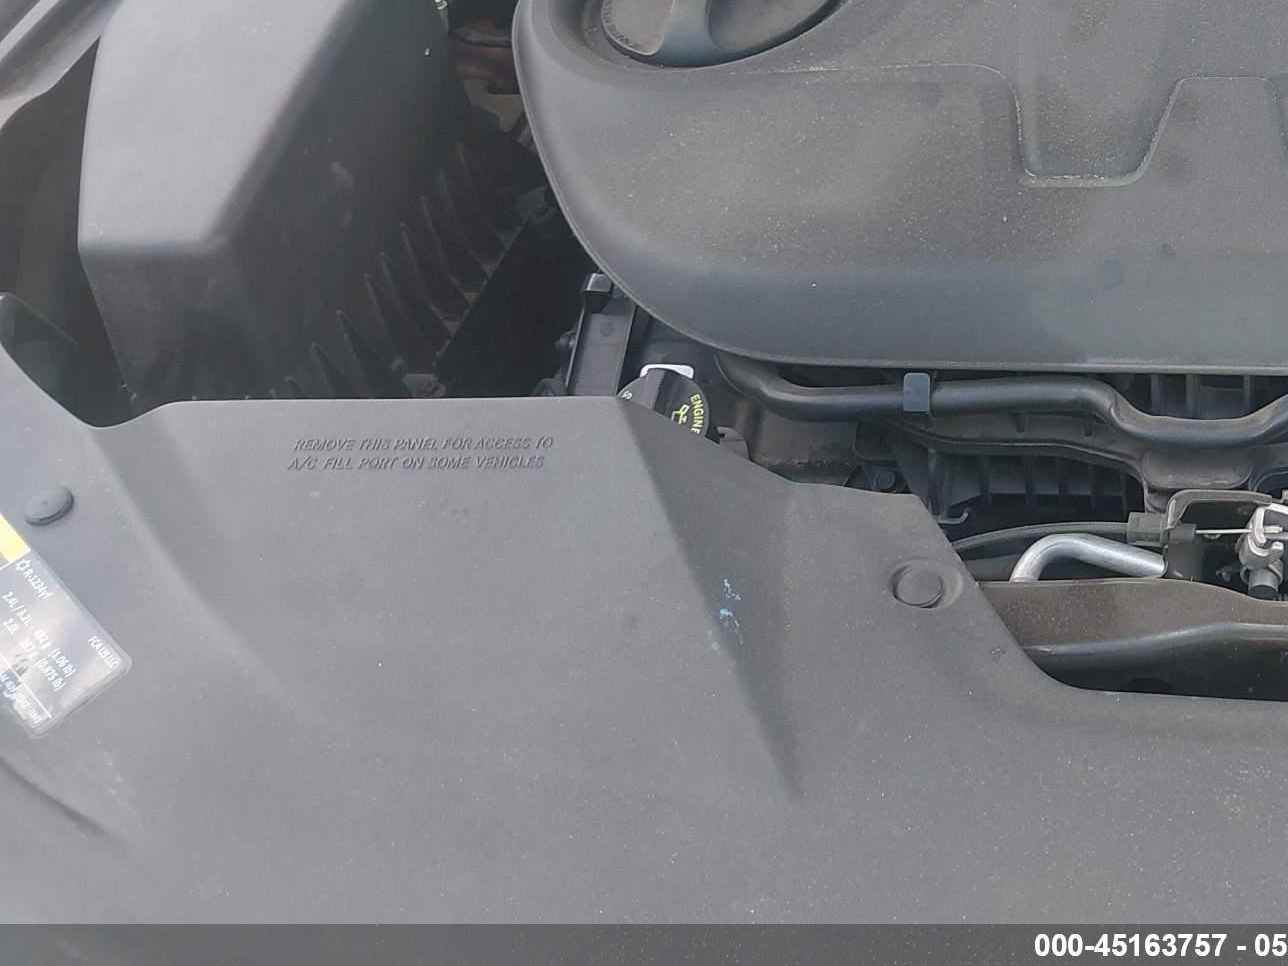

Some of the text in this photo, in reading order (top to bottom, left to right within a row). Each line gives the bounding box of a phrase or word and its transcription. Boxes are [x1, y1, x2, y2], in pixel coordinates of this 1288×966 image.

[294, 436, 554, 451] REMOVE THIS PANEL FOR ACCESS TO
[287, 455, 545, 470] A/C FILL PORT ON SOME VEHICLES
